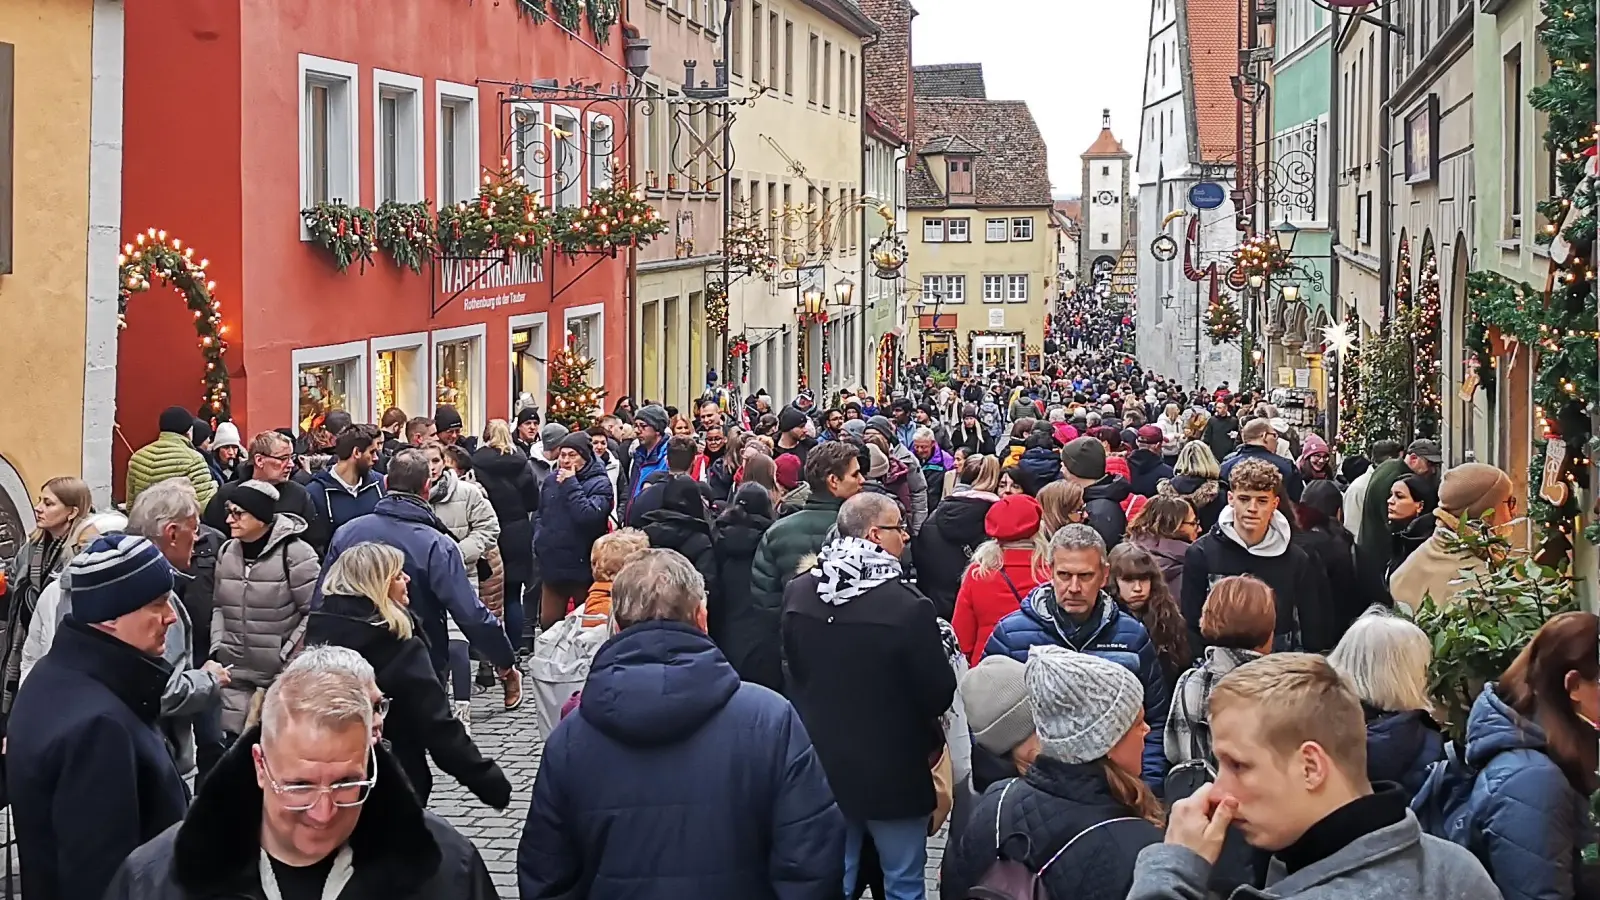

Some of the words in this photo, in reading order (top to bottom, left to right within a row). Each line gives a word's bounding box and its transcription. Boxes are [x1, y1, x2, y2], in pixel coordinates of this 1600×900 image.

[464, 295, 495, 310] Rothenburg
[495, 294, 502, 306] ob
[502, 292, 510, 305] der
[509, 291, 526, 304] Tauber
